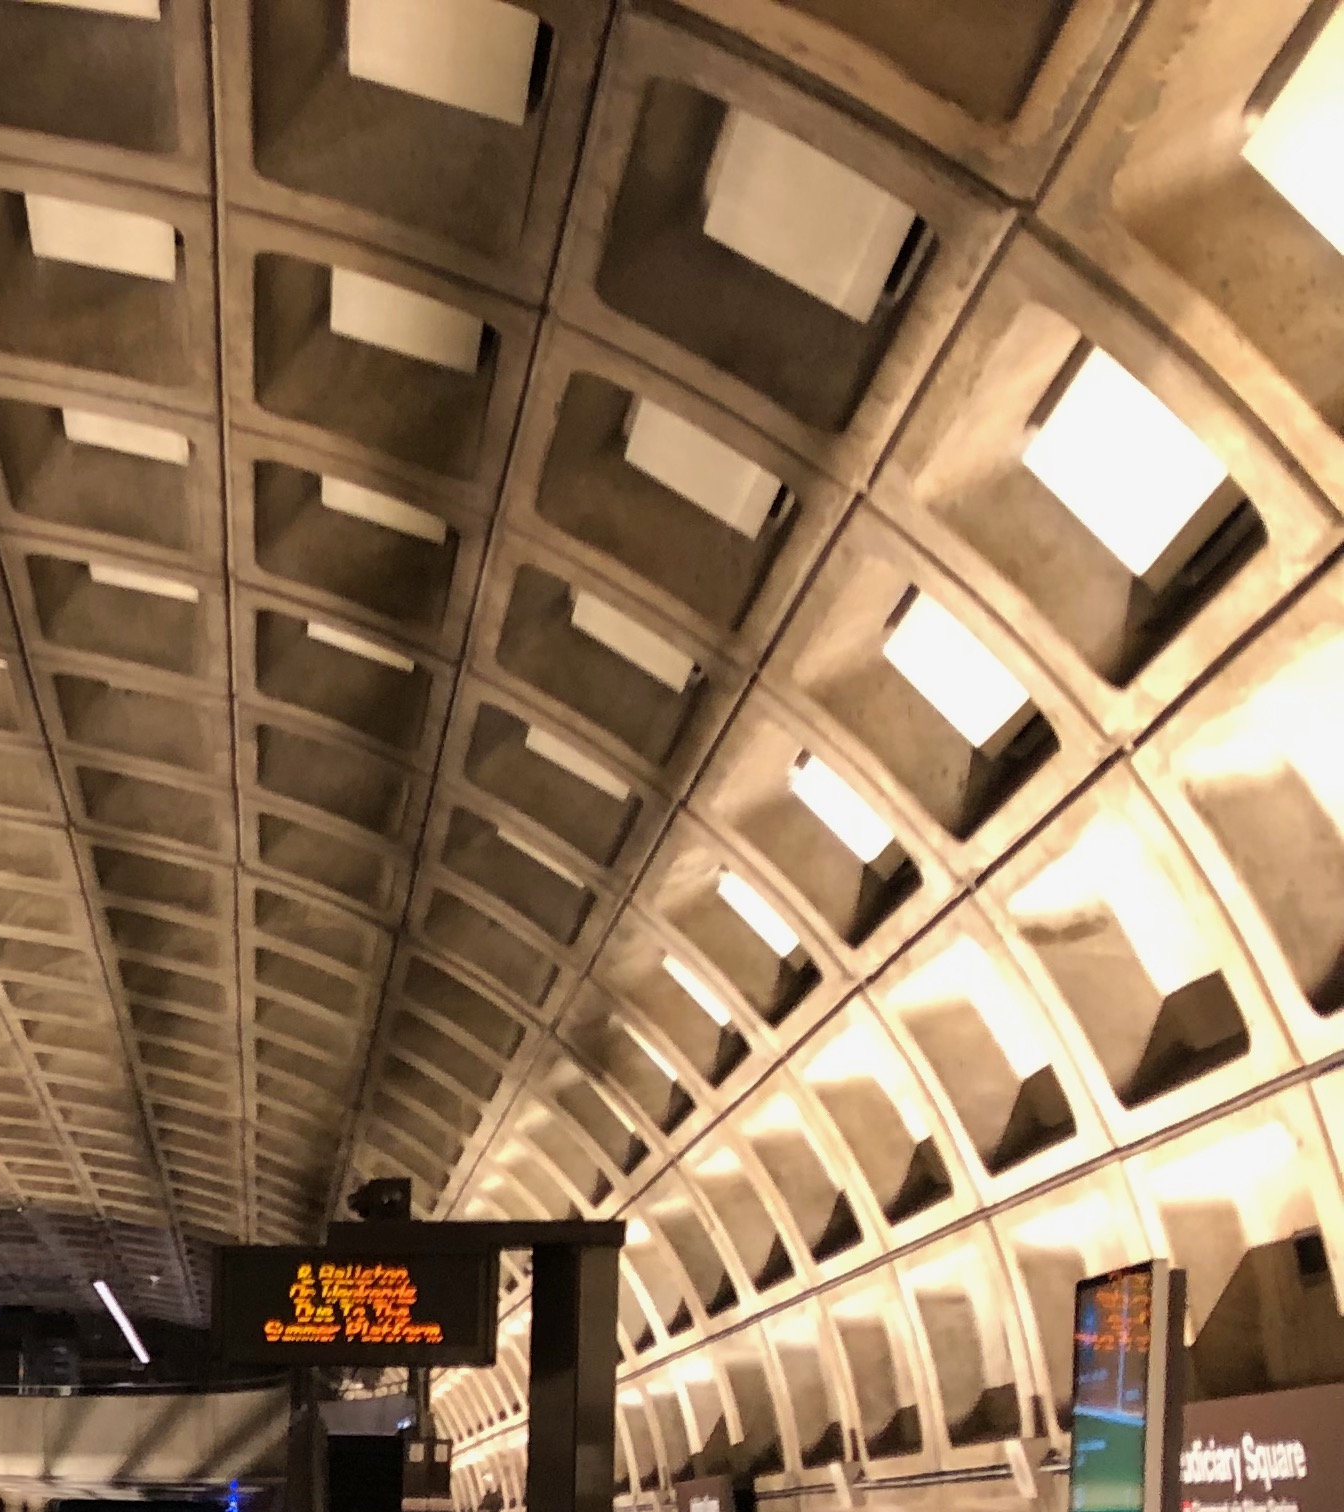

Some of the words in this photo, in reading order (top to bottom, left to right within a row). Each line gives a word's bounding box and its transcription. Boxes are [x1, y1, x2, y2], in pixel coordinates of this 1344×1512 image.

[318, 1264, 411, 1286] Ballston
[264, 1320, 342, 1342] Summer
[345, 1320, 444, 1343] Platform
[1242, 1432, 1308, 1492] Square
